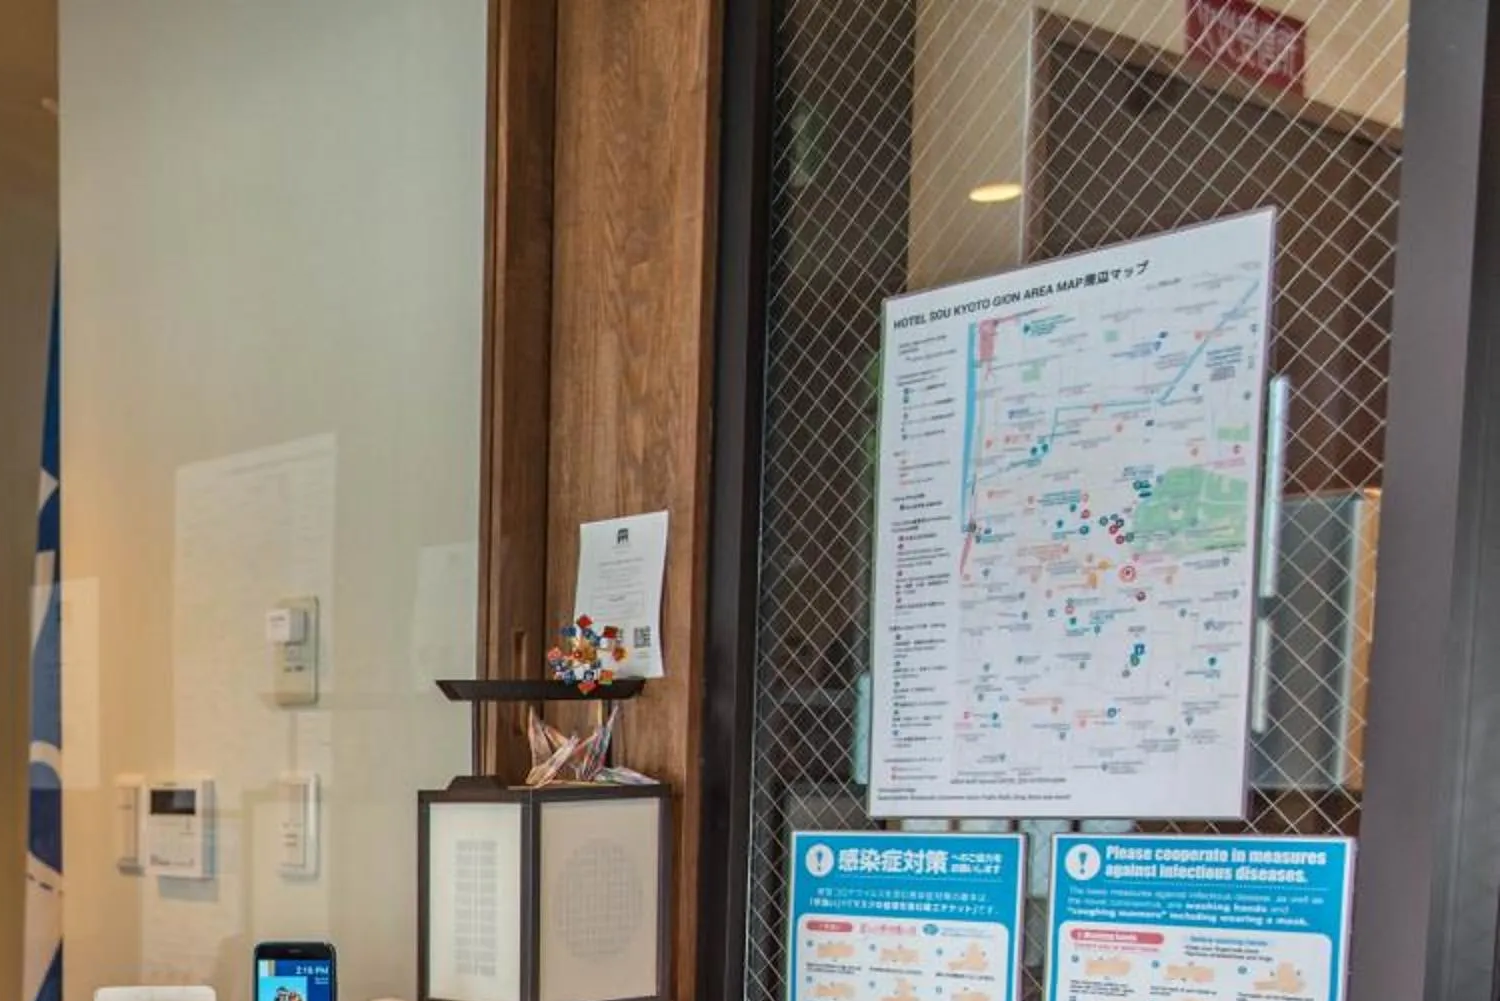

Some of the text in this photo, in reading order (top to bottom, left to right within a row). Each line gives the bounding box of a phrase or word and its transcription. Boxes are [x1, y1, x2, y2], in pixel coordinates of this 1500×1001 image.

[893, 314, 927, 330] HOTEL
[929, 307, 951, 320] SOU
[953, 298, 991, 317] KYOTO
[992, 291, 1021, 308] GION
[1023, 284, 1054, 300] AREA
[838, 848, 949, 875] 感染症対策
[1106, 845, 1326, 865] Please cooperate in measures
[1105, 863, 1308, 884] against infectious diseases.
[1233, 902, 1267, 913] hands
[315, 966, 329, 975] PM
